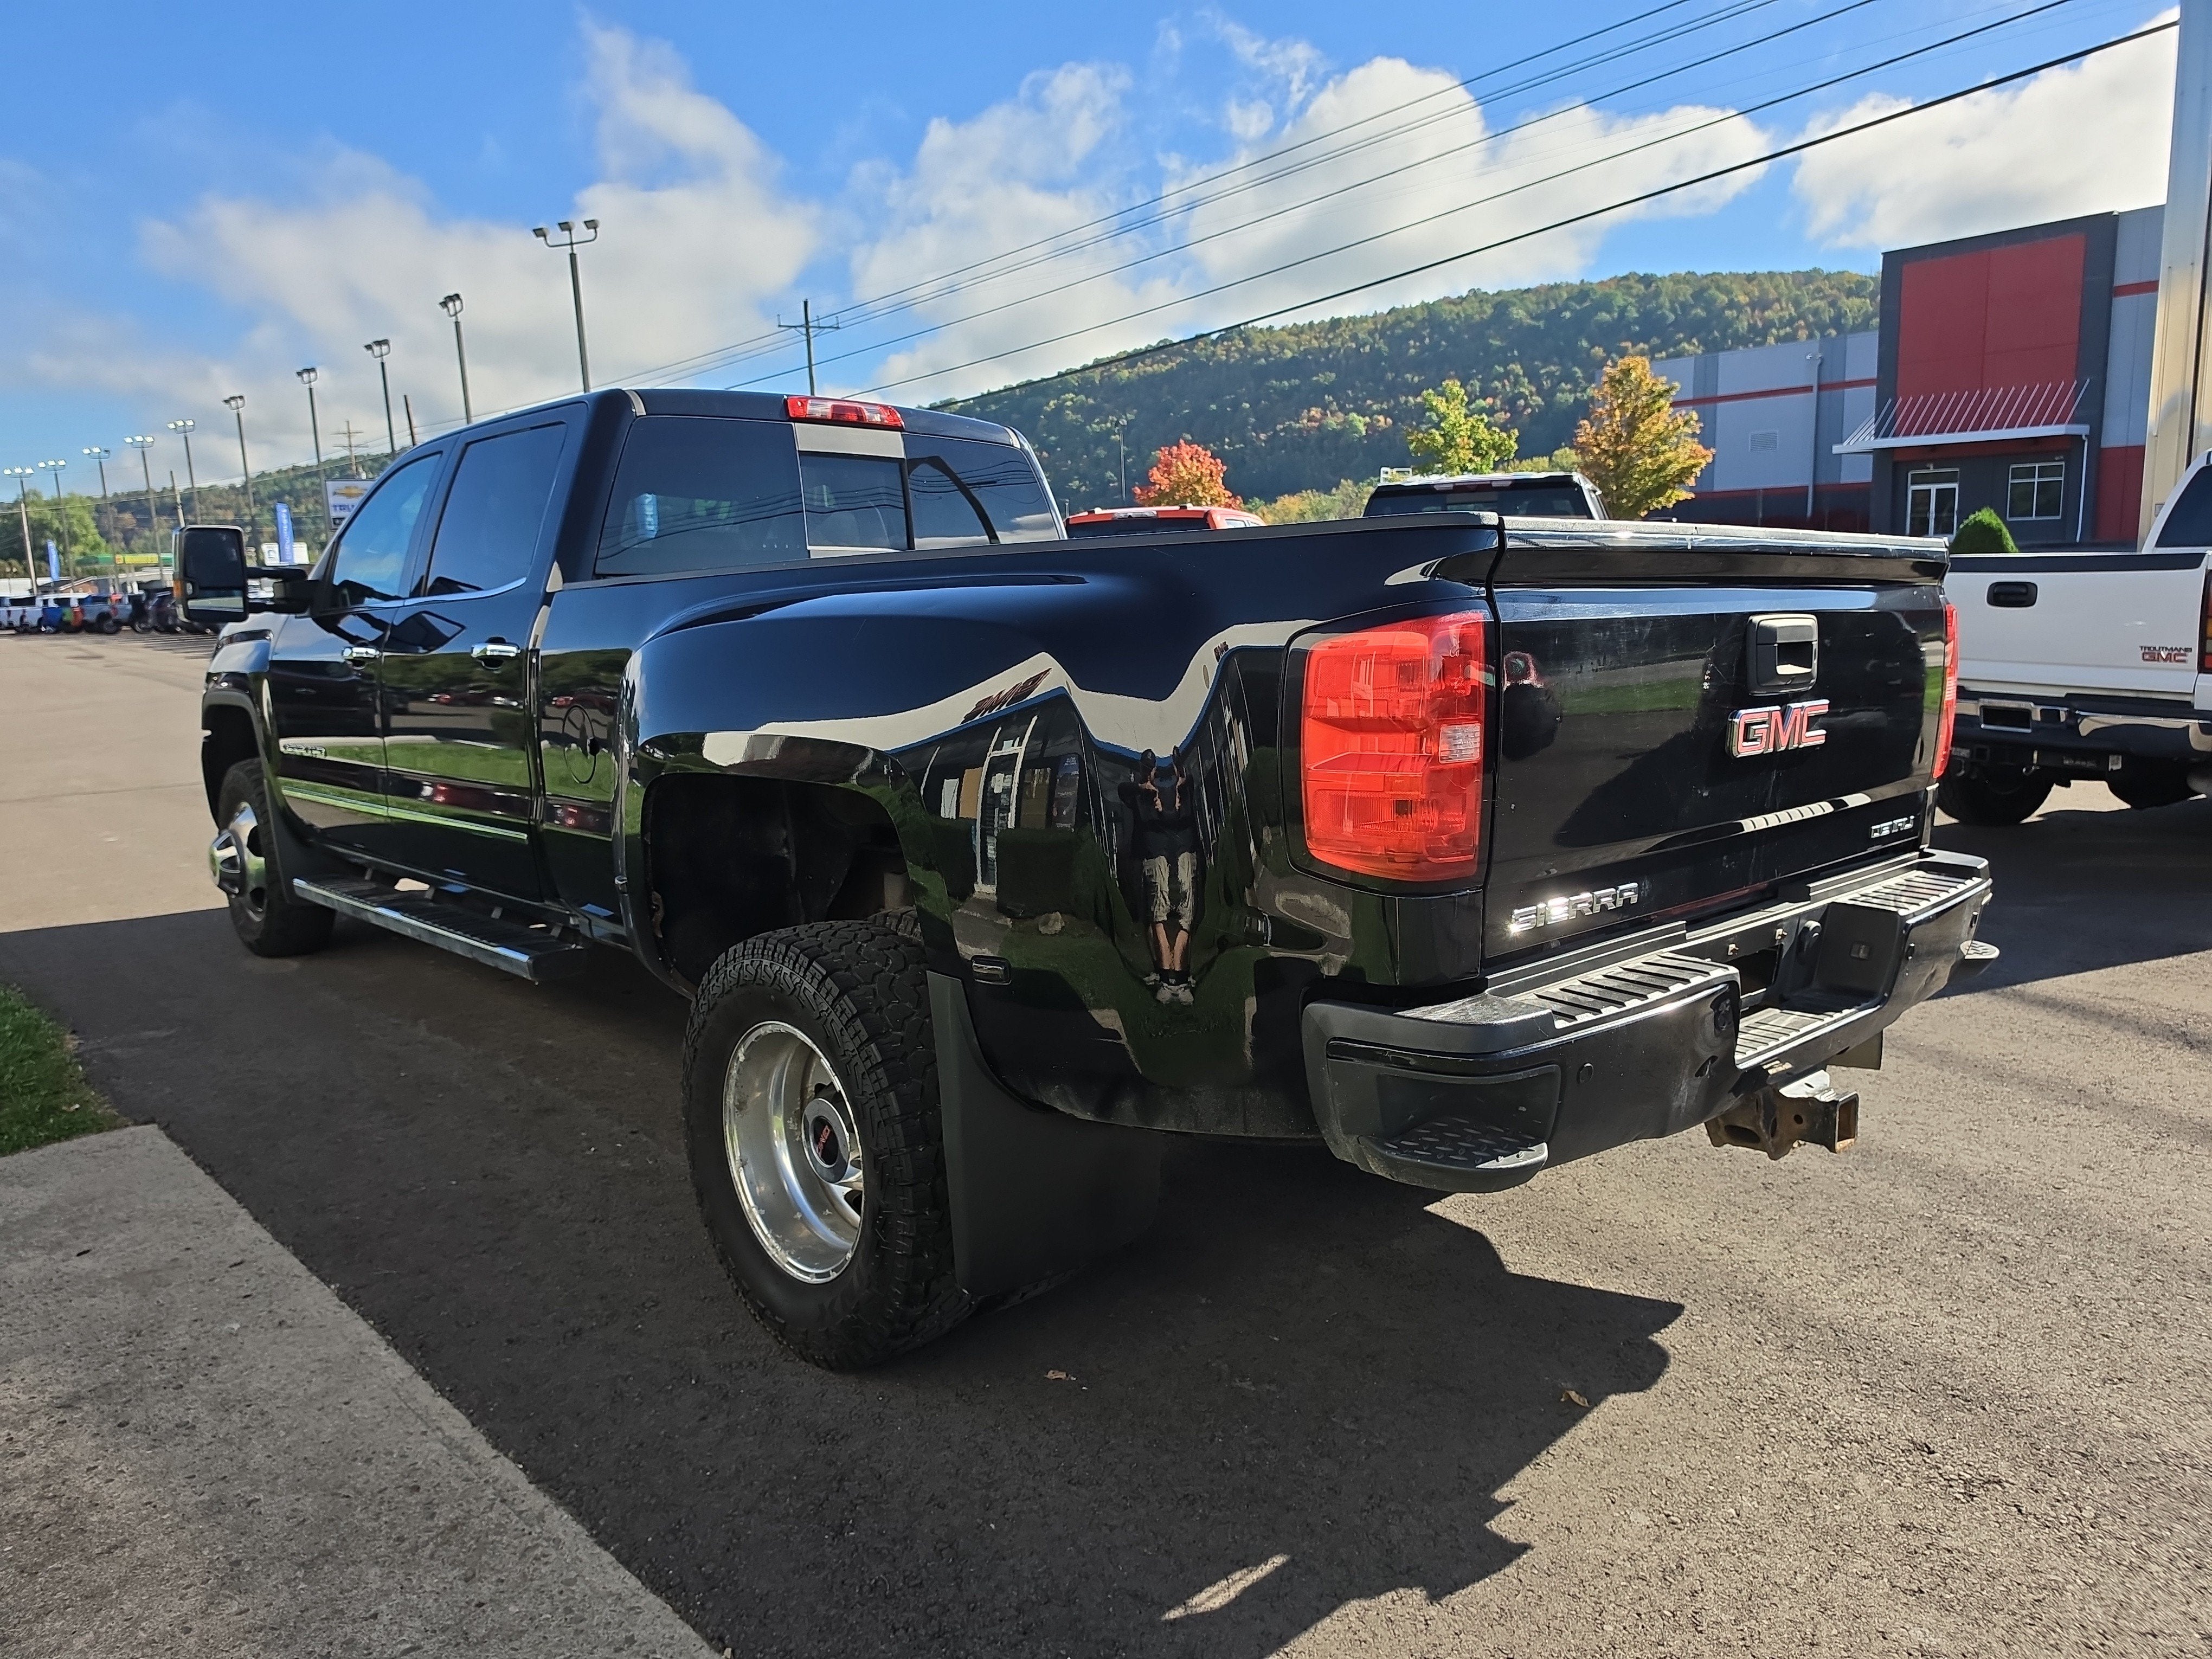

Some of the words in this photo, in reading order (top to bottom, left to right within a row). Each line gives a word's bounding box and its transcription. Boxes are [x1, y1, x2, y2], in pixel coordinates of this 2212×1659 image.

[2142, 652, 2189, 663] GMC
[1726, 699, 1830, 758] GMC
[1510, 882, 1638, 932] SIERRA
